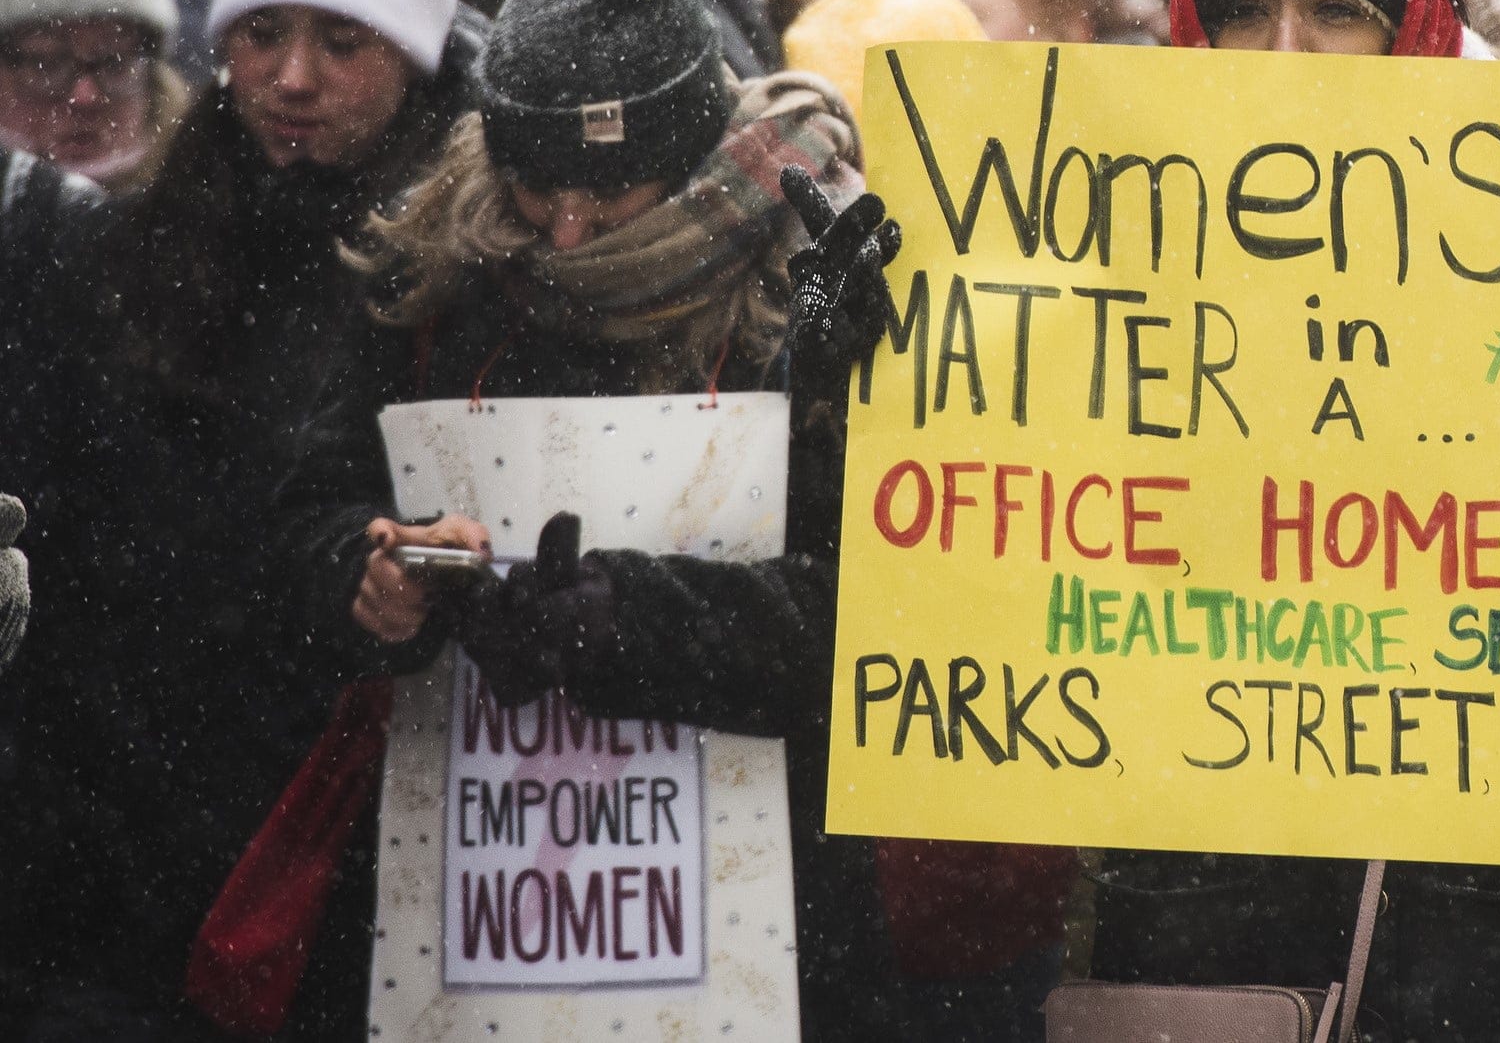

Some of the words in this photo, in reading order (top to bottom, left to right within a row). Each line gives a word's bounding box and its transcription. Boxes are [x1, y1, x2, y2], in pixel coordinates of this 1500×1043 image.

[859, 269, 1250, 440] MATTER
[1304, 292, 1391, 368] in
[1310, 377, 1365, 442] A
[873, 459, 1192, 577] OFFICE,
[1046, 572, 1417, 675] HEALTHCARE,
[855, 653, 1125, 778] PARKS,
[1181, 679, 1496, 794] STREET,
[460, 777, 682, 849] EMPOWER
[462, 866, 683, 964] WOMEN
